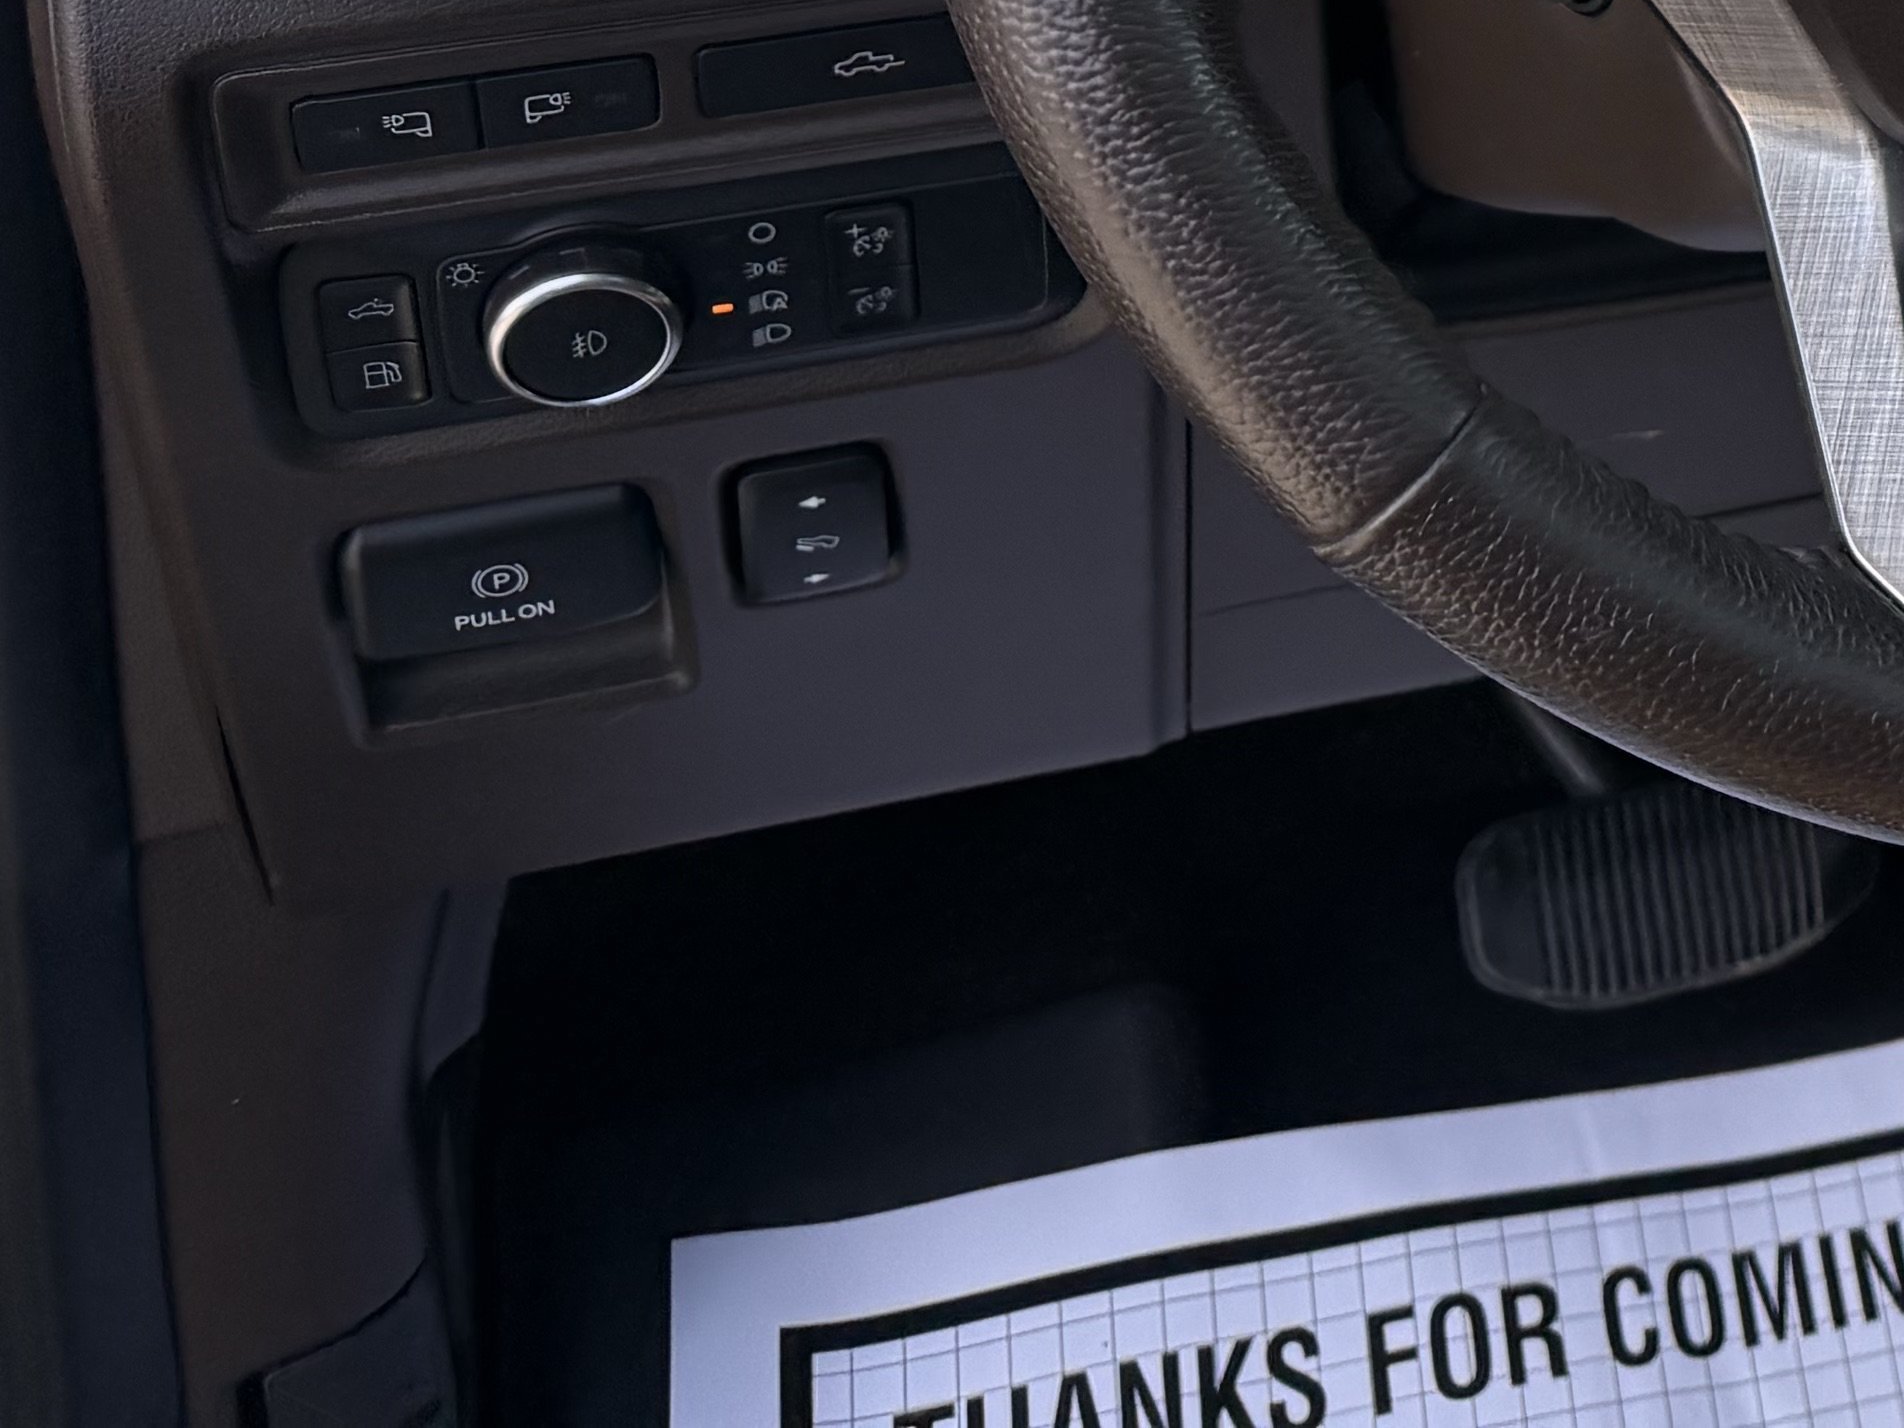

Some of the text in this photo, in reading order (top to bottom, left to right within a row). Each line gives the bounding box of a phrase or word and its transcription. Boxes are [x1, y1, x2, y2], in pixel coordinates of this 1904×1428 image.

[454, 599, 555, 631] PULL ON
[1369, 1281, 1569, 1417] FOR
